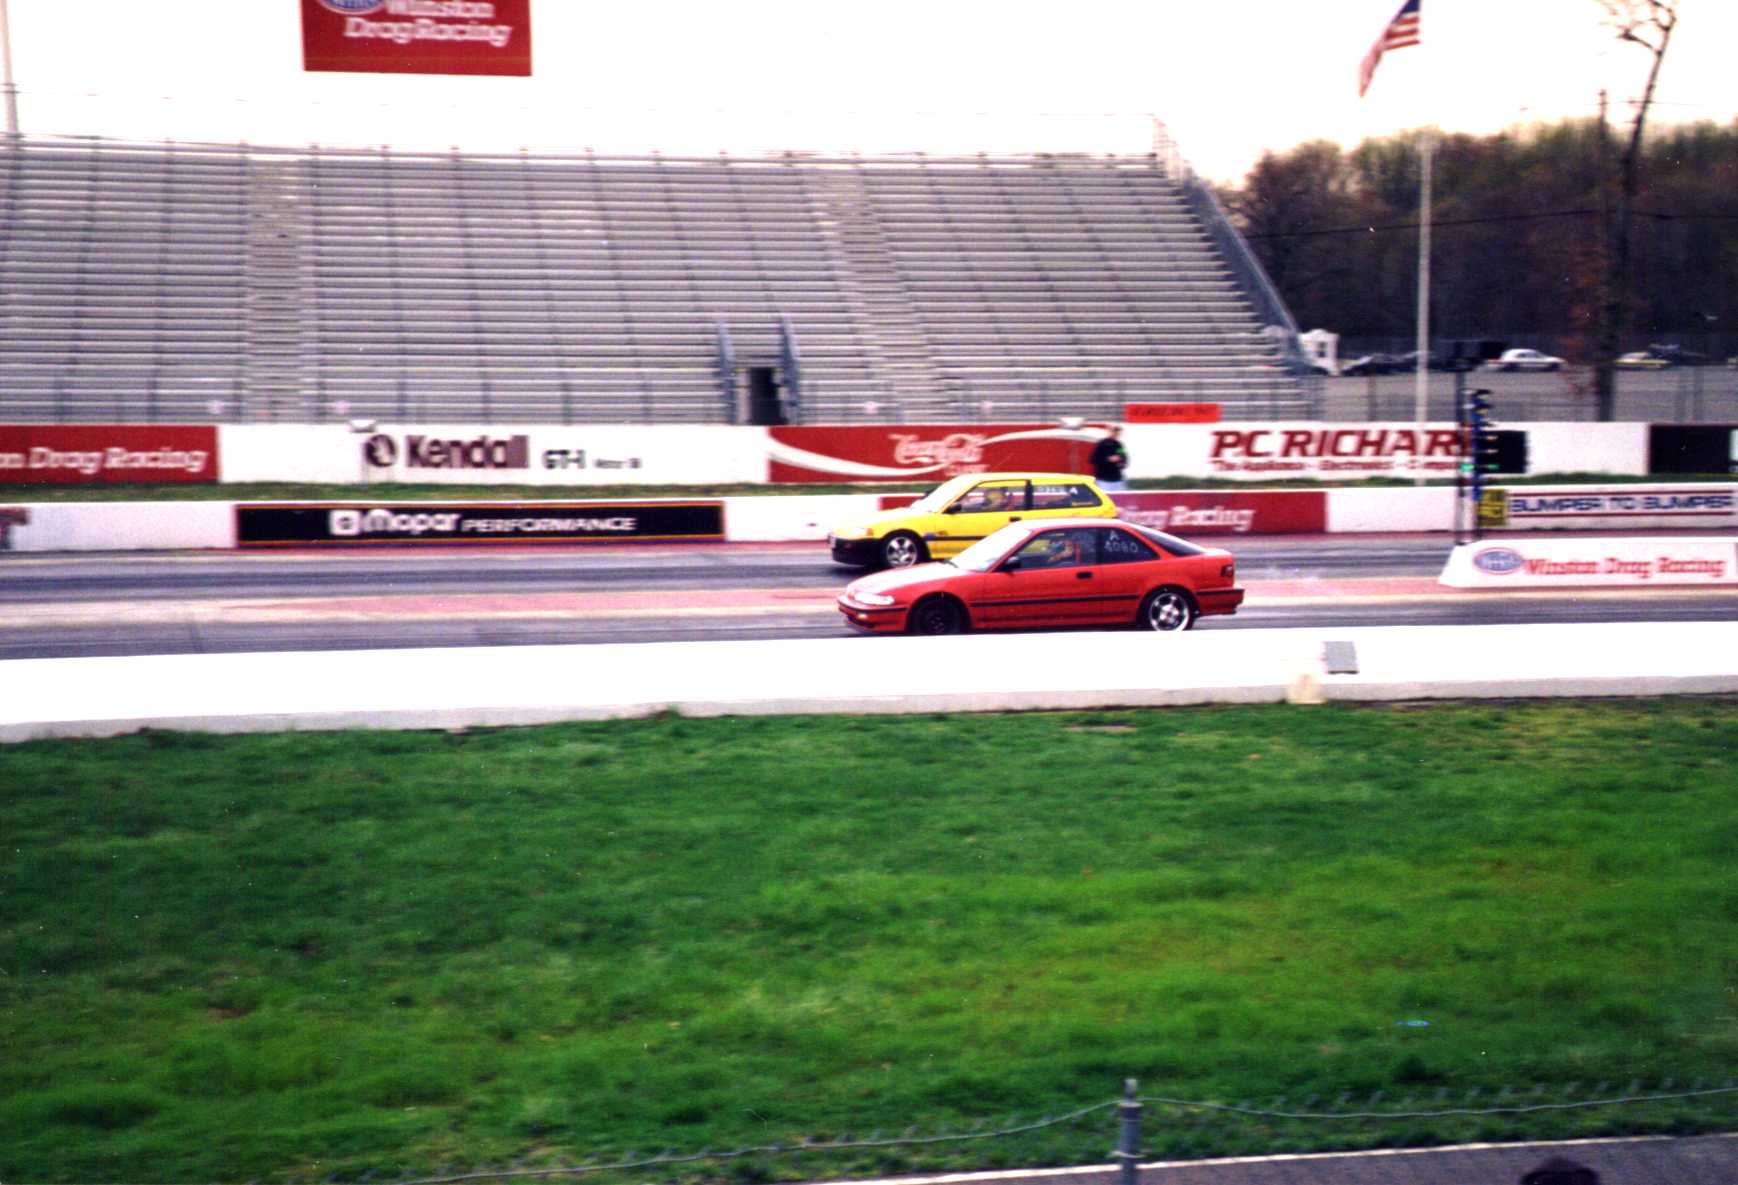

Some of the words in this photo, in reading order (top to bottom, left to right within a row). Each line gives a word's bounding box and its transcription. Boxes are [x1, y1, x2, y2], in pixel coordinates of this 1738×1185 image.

[345, 17, 413, 44] Drag
[413, 18, 512, 47] Racing
[406, 434, 529, 468] Kendall
[1210, 430, 1271, 457] PC
[29, 447, 101, 474] Drag
[103, 447, 207, 472] Racing
[1511, 498, 1601, 512] BUMPER
[1643, 495, 1733, 509] BUMPER
[363, 509, 461, 535] Mopar
[461, 517, 637, 533] PERFORMANCE
[1169, 506, 1256, 532] Racing
[1524, 558, 1598, 575] Winston
